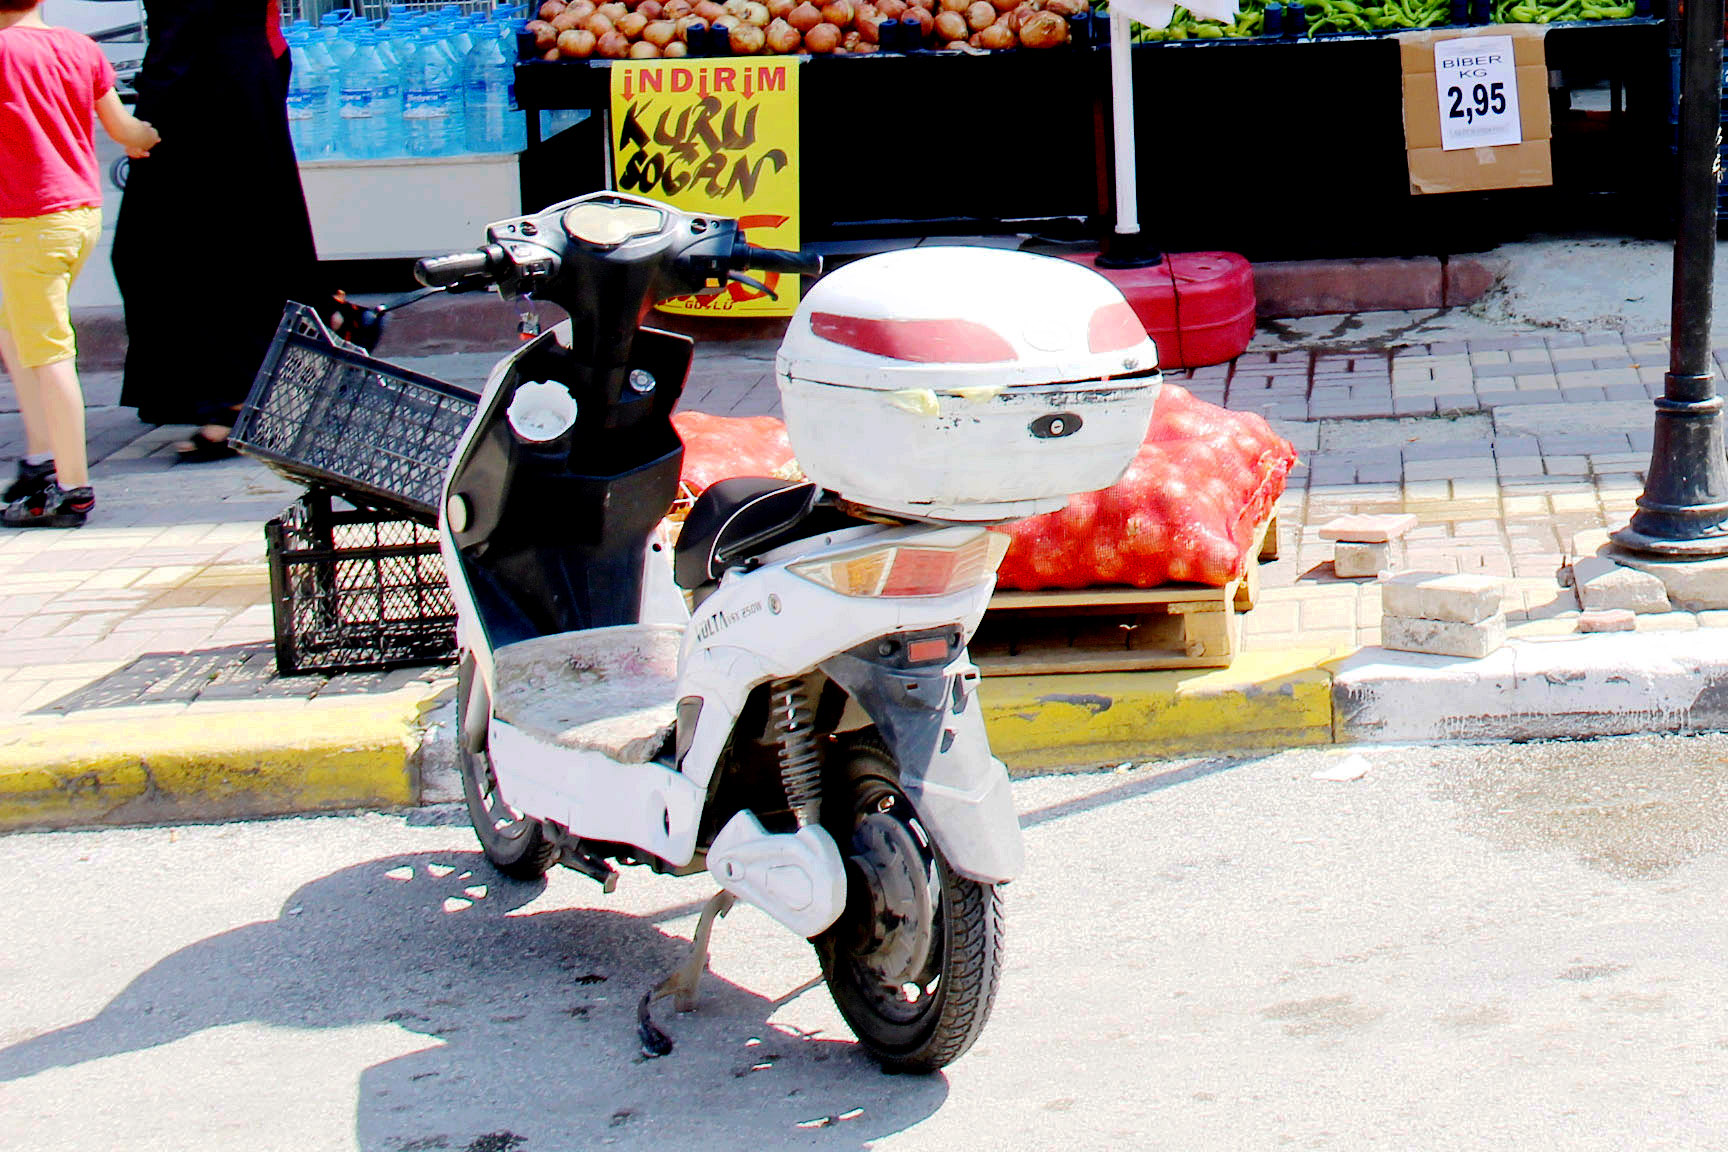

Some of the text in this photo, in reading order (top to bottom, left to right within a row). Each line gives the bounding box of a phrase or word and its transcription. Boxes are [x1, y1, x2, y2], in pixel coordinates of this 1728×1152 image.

[1443, 55, 1503, 69] BİBER
[1460, 68, 1488, 79] KG
[1447, 82, 1506, 125] 2,95
[619, 96, 761, 154] KURU
